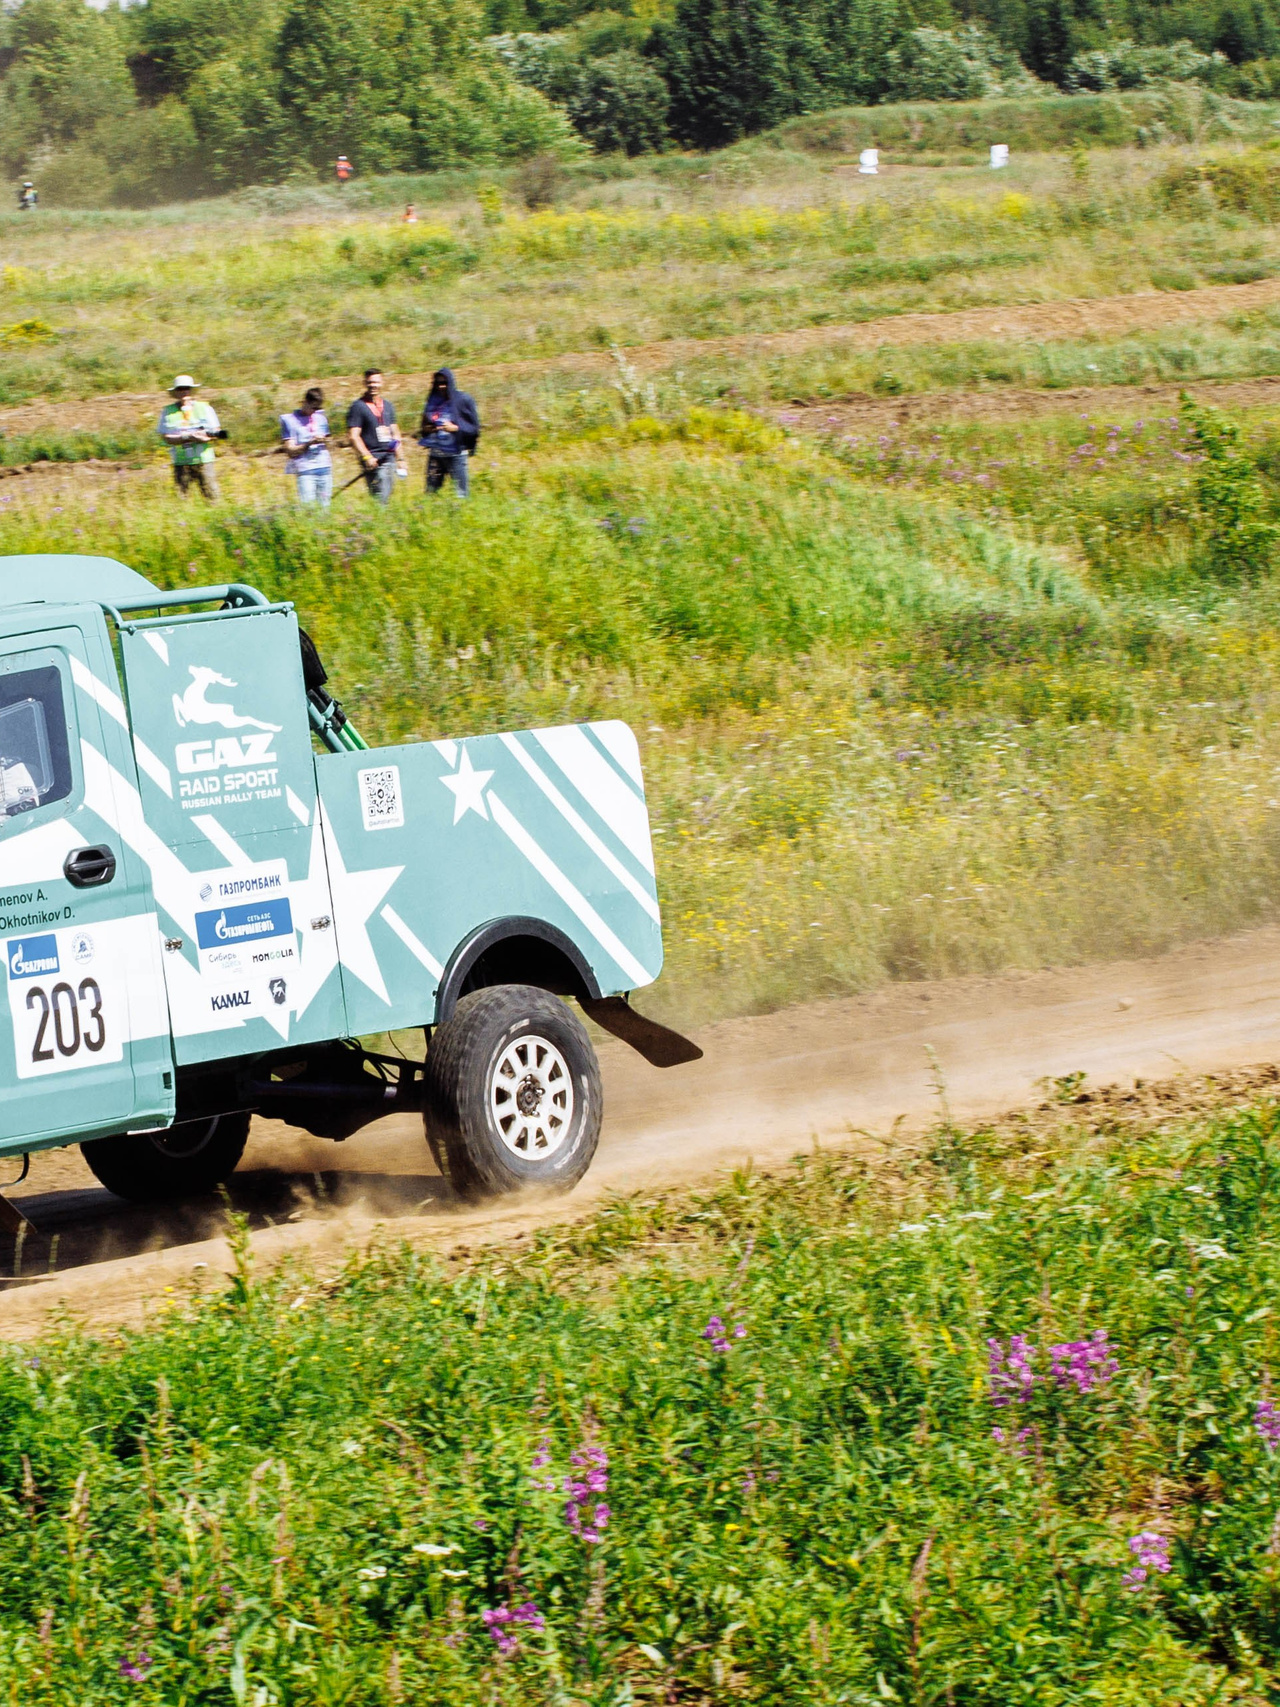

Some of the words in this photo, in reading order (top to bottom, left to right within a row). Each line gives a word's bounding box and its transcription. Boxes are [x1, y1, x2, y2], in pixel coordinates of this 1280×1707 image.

[174, 732, 277, 774] GAZ
[179, 776, 221, 796] RAID
[223, 768, 279, 791] SPORT
[181, 796, 222, 810] RUSSIAN
[224, 791, 253, 804] RALLY
[255, 787, 282, 800] TEAM
[36, 888, 48, 901] A.
[219, 874, 282, 896] ГАЗПРОМБАНК
[63, 906, 76, 919] D.
[211, 990, 252, 1011] KAMAZ
[25, 976, 106, 1063] 203
